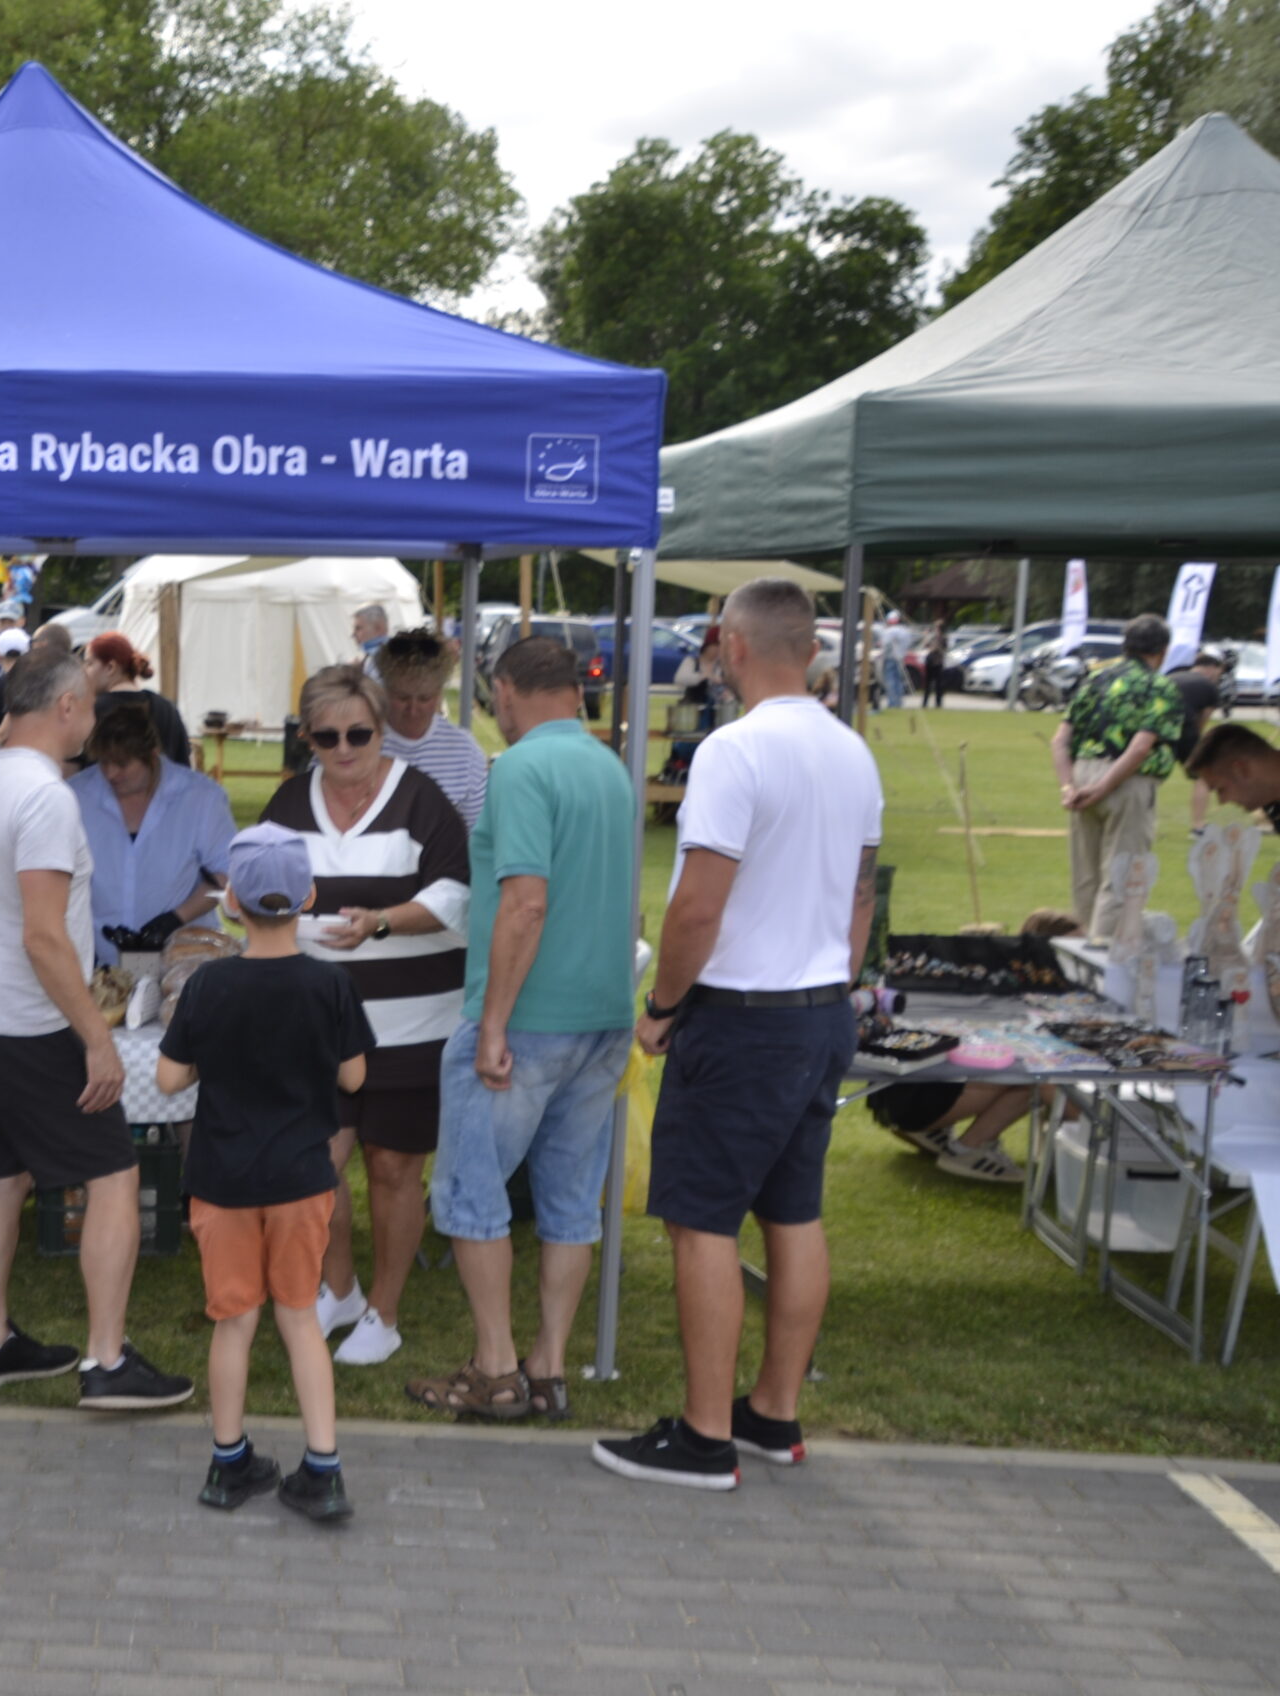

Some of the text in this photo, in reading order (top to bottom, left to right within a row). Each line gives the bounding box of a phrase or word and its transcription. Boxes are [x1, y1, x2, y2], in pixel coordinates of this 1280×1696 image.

[32, 432, 198, 480] Rybacka
[213, 435, 306, 475] Obra
[351, 439, 467, 478] Warta
